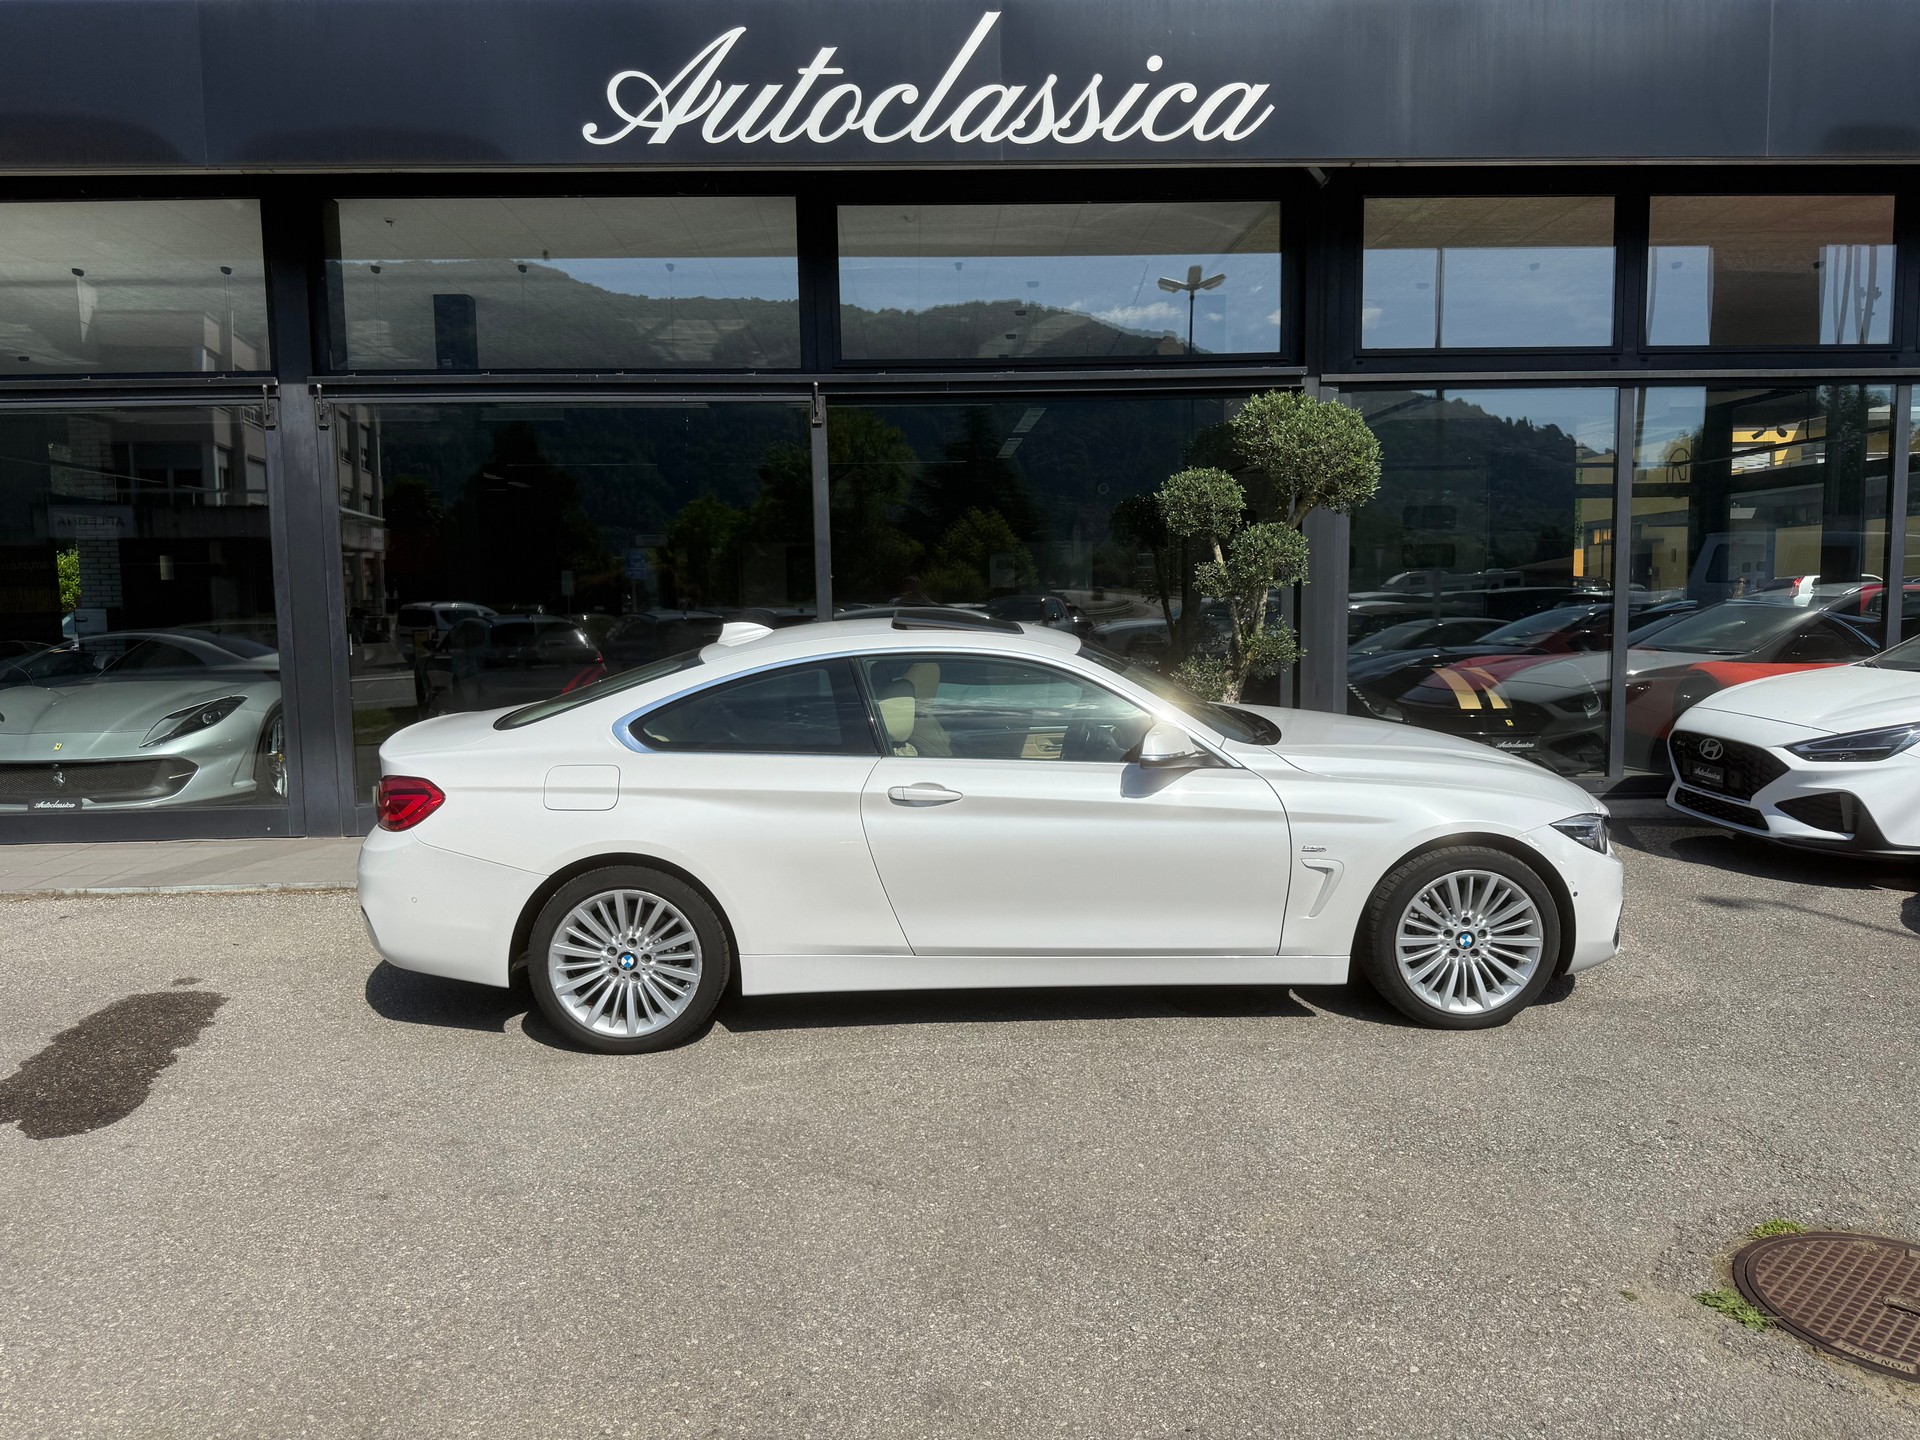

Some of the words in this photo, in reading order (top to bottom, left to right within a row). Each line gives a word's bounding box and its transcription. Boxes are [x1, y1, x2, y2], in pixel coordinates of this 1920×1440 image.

[582, 10, 1275, 145] Autoclassica
[1841, 1343, 1876, 1361] ROLL
[1880, 1358, 1911, 1372] VON
